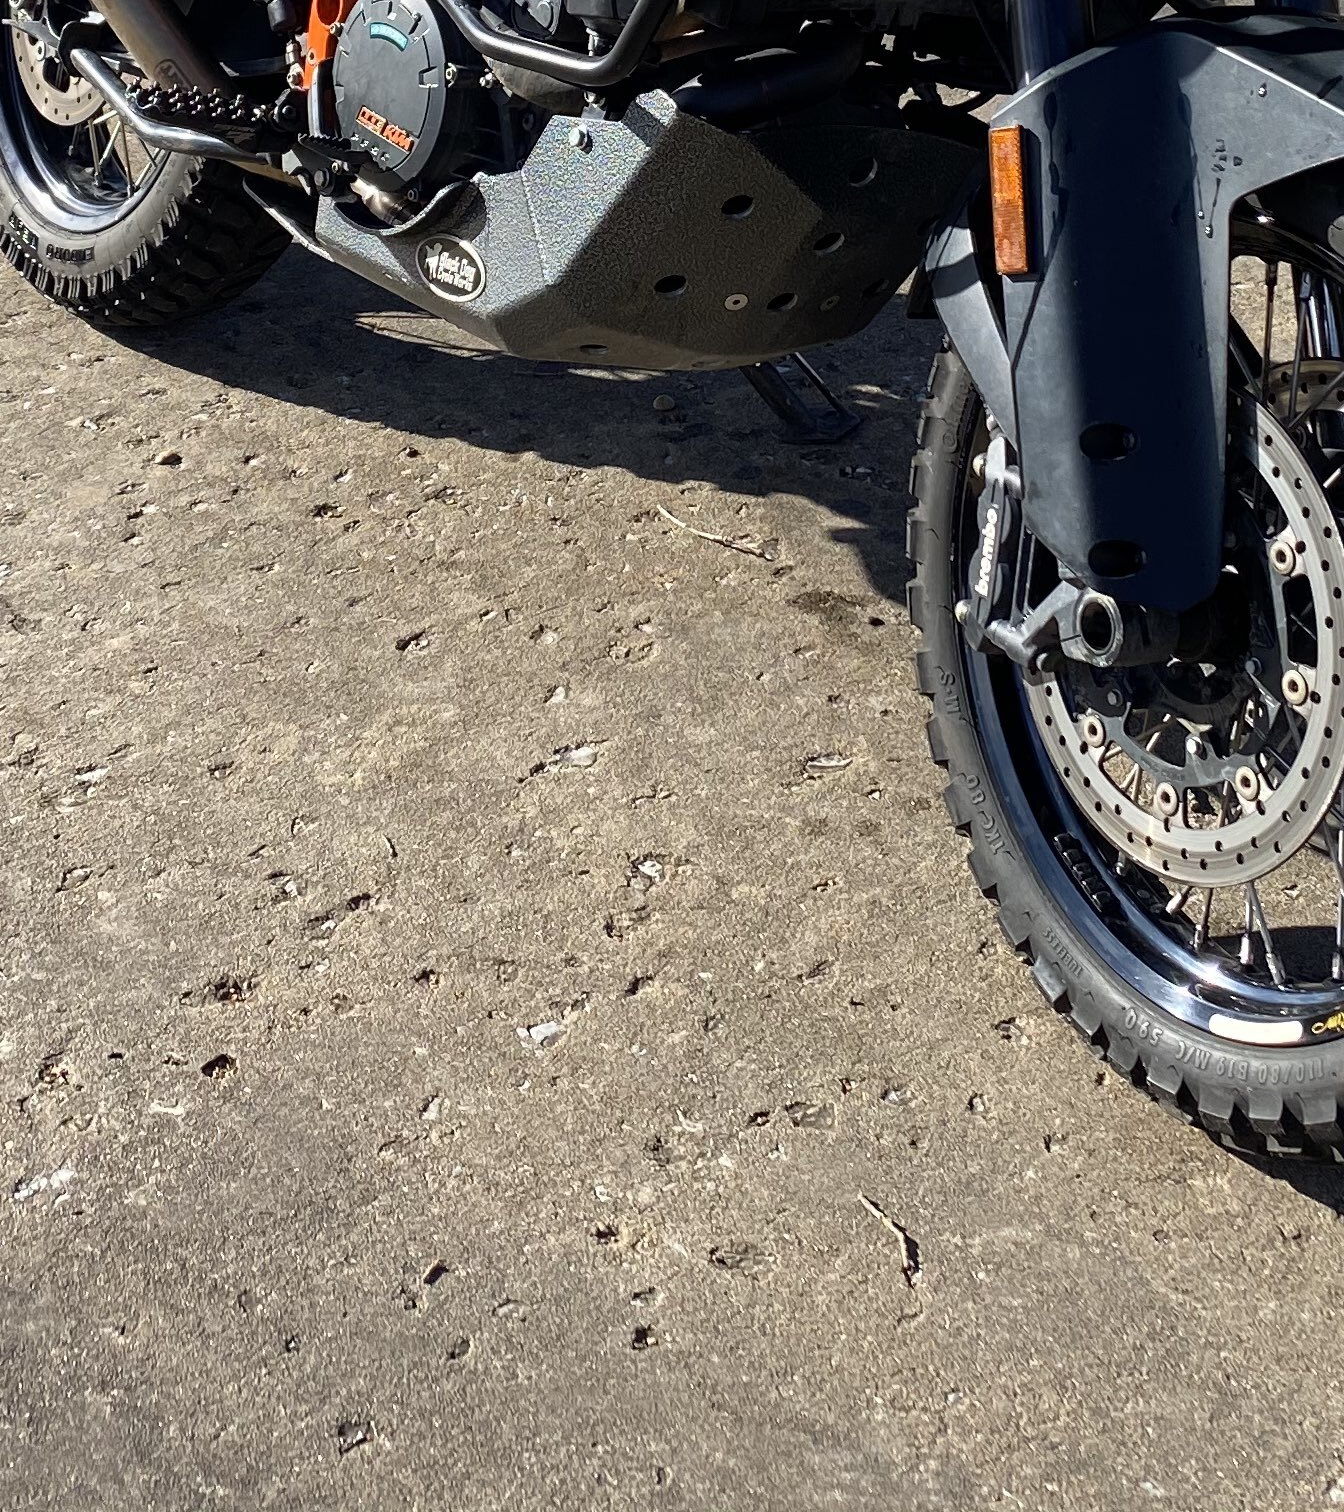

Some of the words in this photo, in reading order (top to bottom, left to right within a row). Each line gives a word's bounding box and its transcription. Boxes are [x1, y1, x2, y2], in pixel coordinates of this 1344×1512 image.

[440, 251, 460, 273] Black
[974, 508, 998, 597] brembo
[1042, 925, 1084, 978] TUBELESS
[1175, 1040, 1212, 1070] M/C
